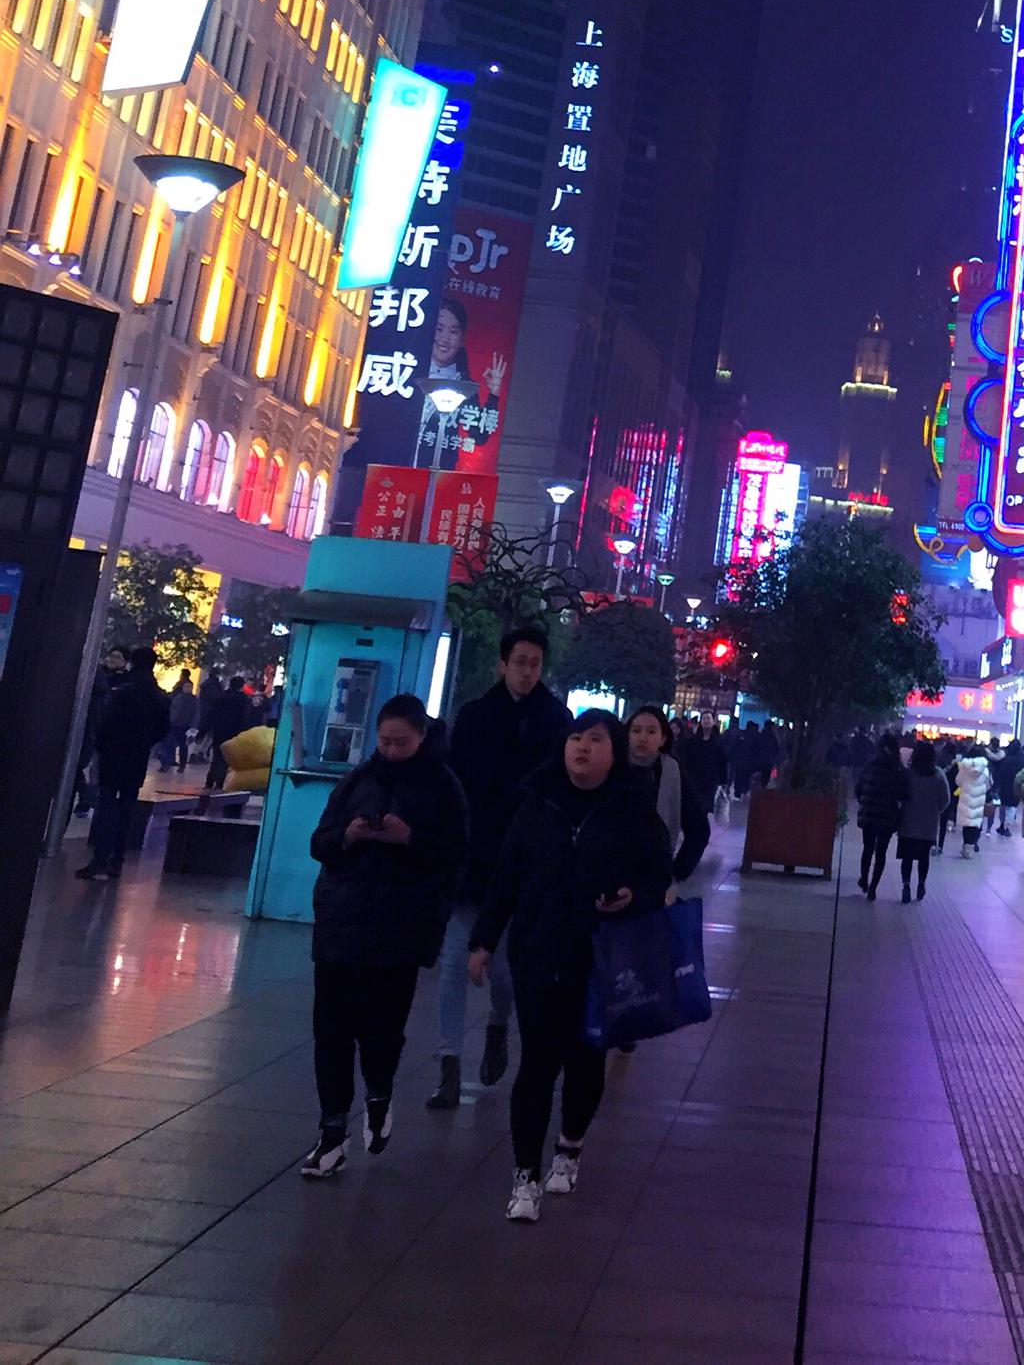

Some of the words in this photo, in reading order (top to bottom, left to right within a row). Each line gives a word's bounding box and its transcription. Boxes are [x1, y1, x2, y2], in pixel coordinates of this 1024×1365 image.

[546, 20, 603, 255] 上海置地广场
